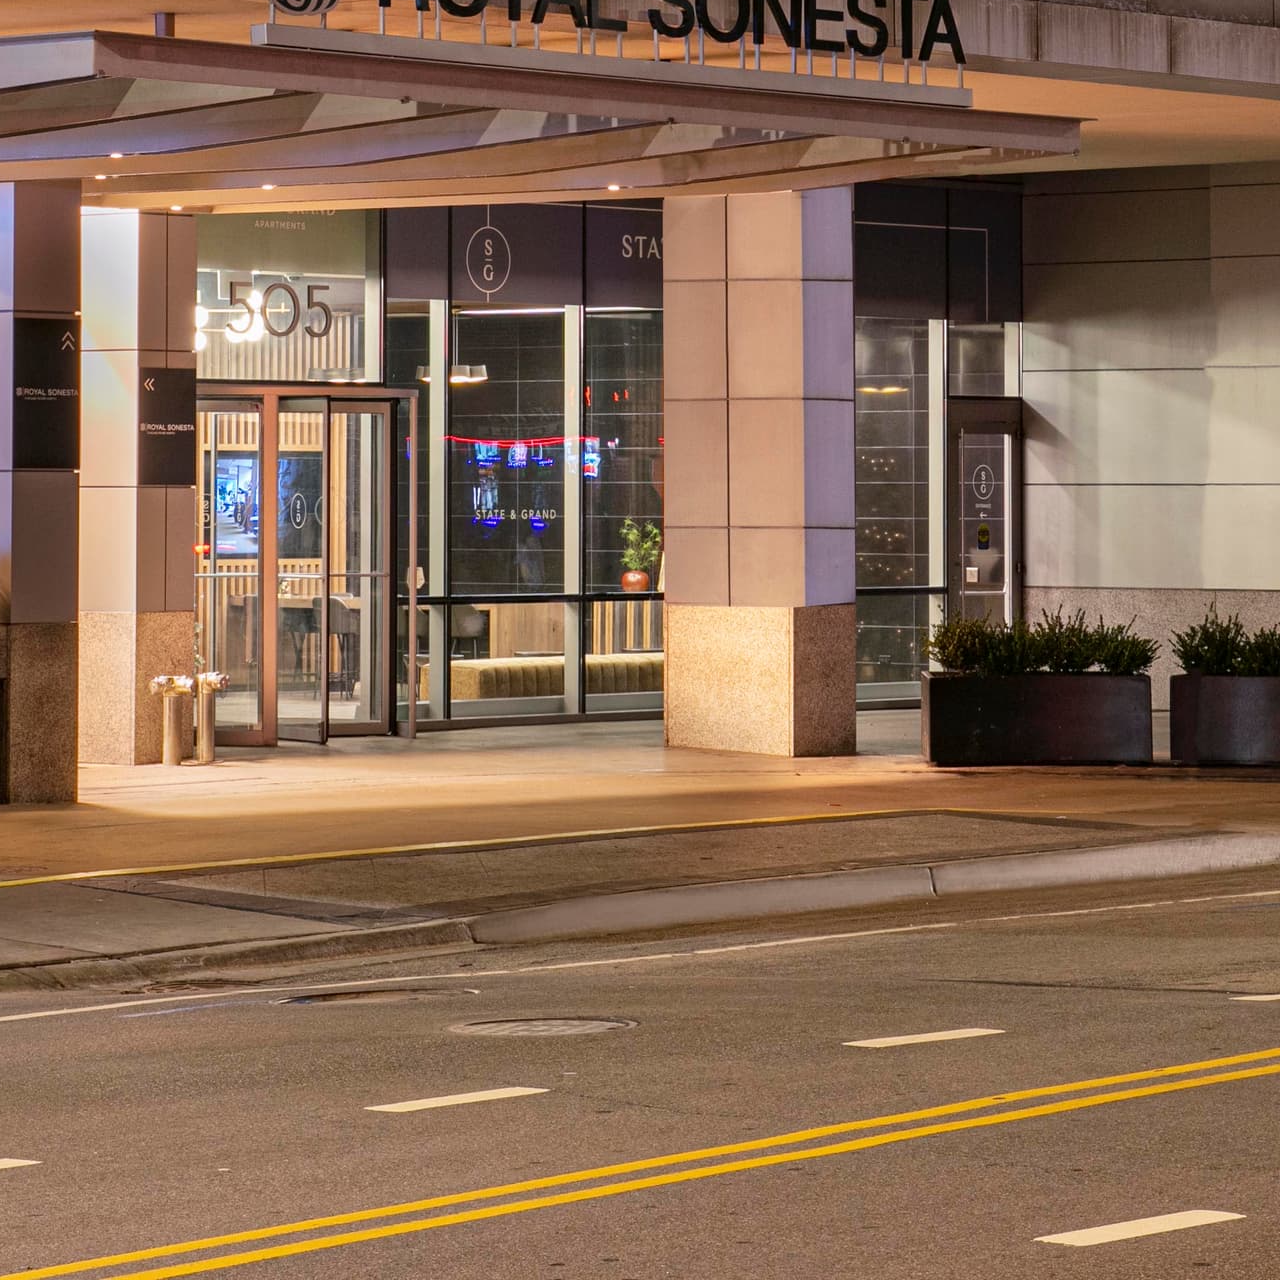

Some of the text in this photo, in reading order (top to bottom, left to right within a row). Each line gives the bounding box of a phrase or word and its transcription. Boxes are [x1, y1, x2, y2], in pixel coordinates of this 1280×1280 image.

[254, 220, 306, 231] APARTMENTS
[621, 233, 664, 260] STA
[226, 281, 333, 338] 505
[146, 423, 195, 432] ROYAL SONESTA
[475, 509, 557, 520] STATE & GRAND
